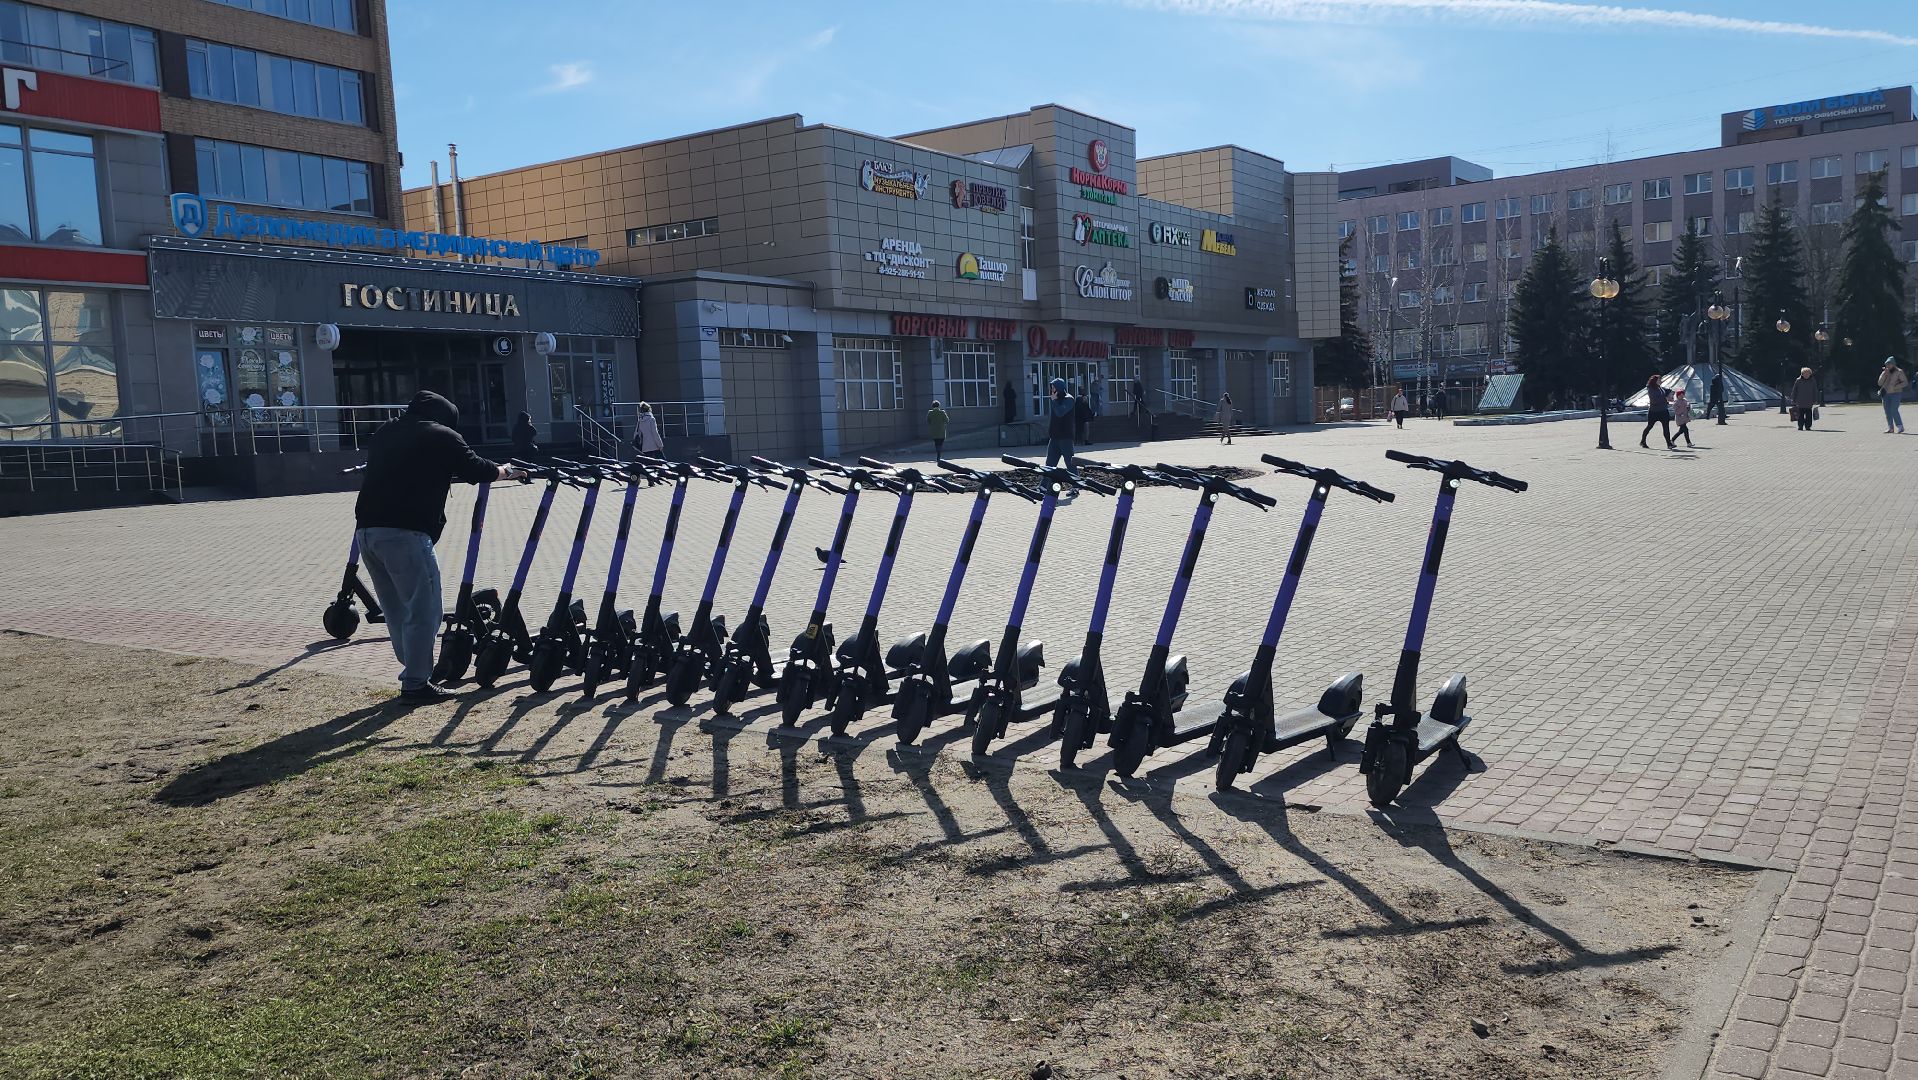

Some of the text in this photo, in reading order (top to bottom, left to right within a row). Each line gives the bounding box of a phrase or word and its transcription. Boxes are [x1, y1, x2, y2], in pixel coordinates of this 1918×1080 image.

[882, 237, 923, 255] АРЕНДА
[1092, 229, 1130, 248] АПТЕКА
[872, 251, 887, 264] ТЦ
[977, 256, 1008, 274] Ташир
[343, 283, 520, 320] ГОСТИНИЦА
[1110, 287, 1133, 301] ШТОР
[198, 330, 224, 338] ЦВЕТЫ
[270, 332, 294, 340] ЦВЕТЫ
[893, 314, 1016, 340] ТОРГОВЫЙ ЦЕНТР
